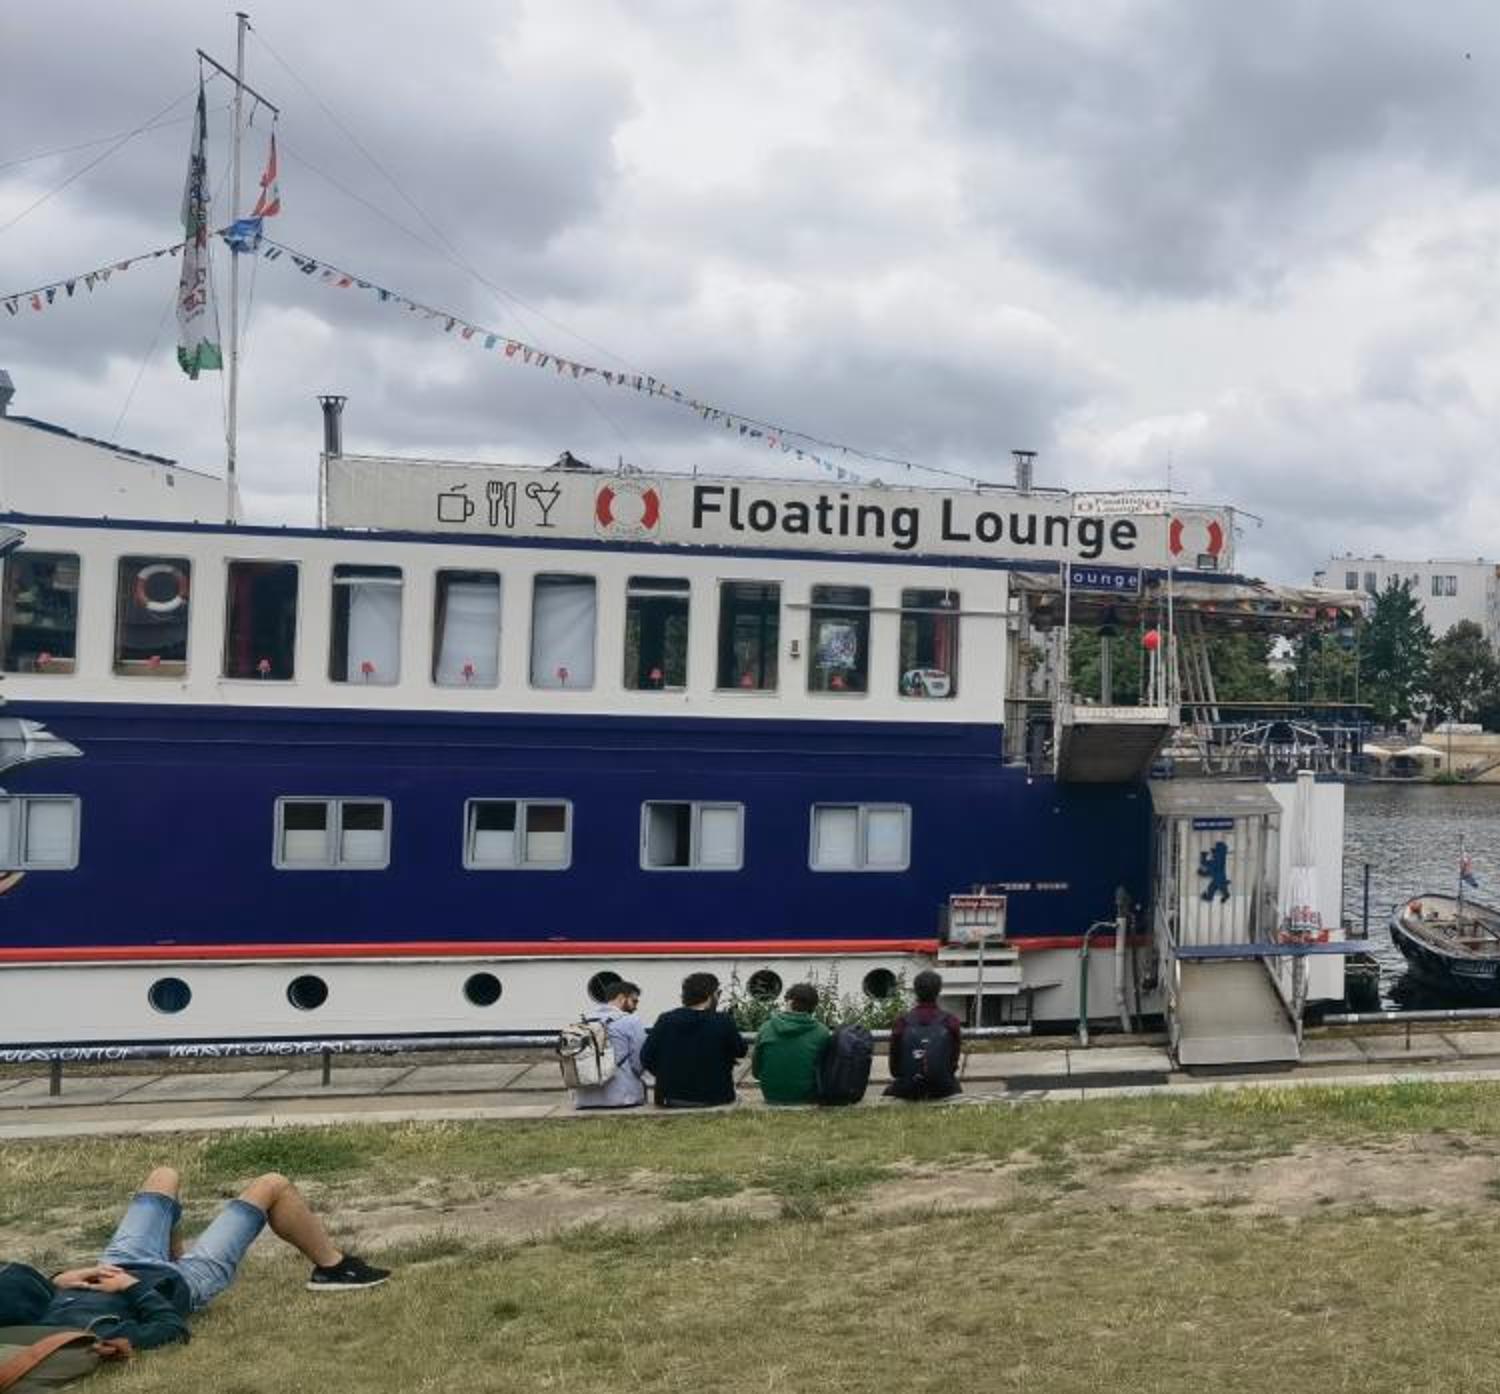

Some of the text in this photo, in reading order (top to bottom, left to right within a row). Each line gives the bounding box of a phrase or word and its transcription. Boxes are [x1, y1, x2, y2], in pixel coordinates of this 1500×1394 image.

[692, 485, 1138, 559] Floating Lounge
[1073, 573, 1137, 587] ounge
